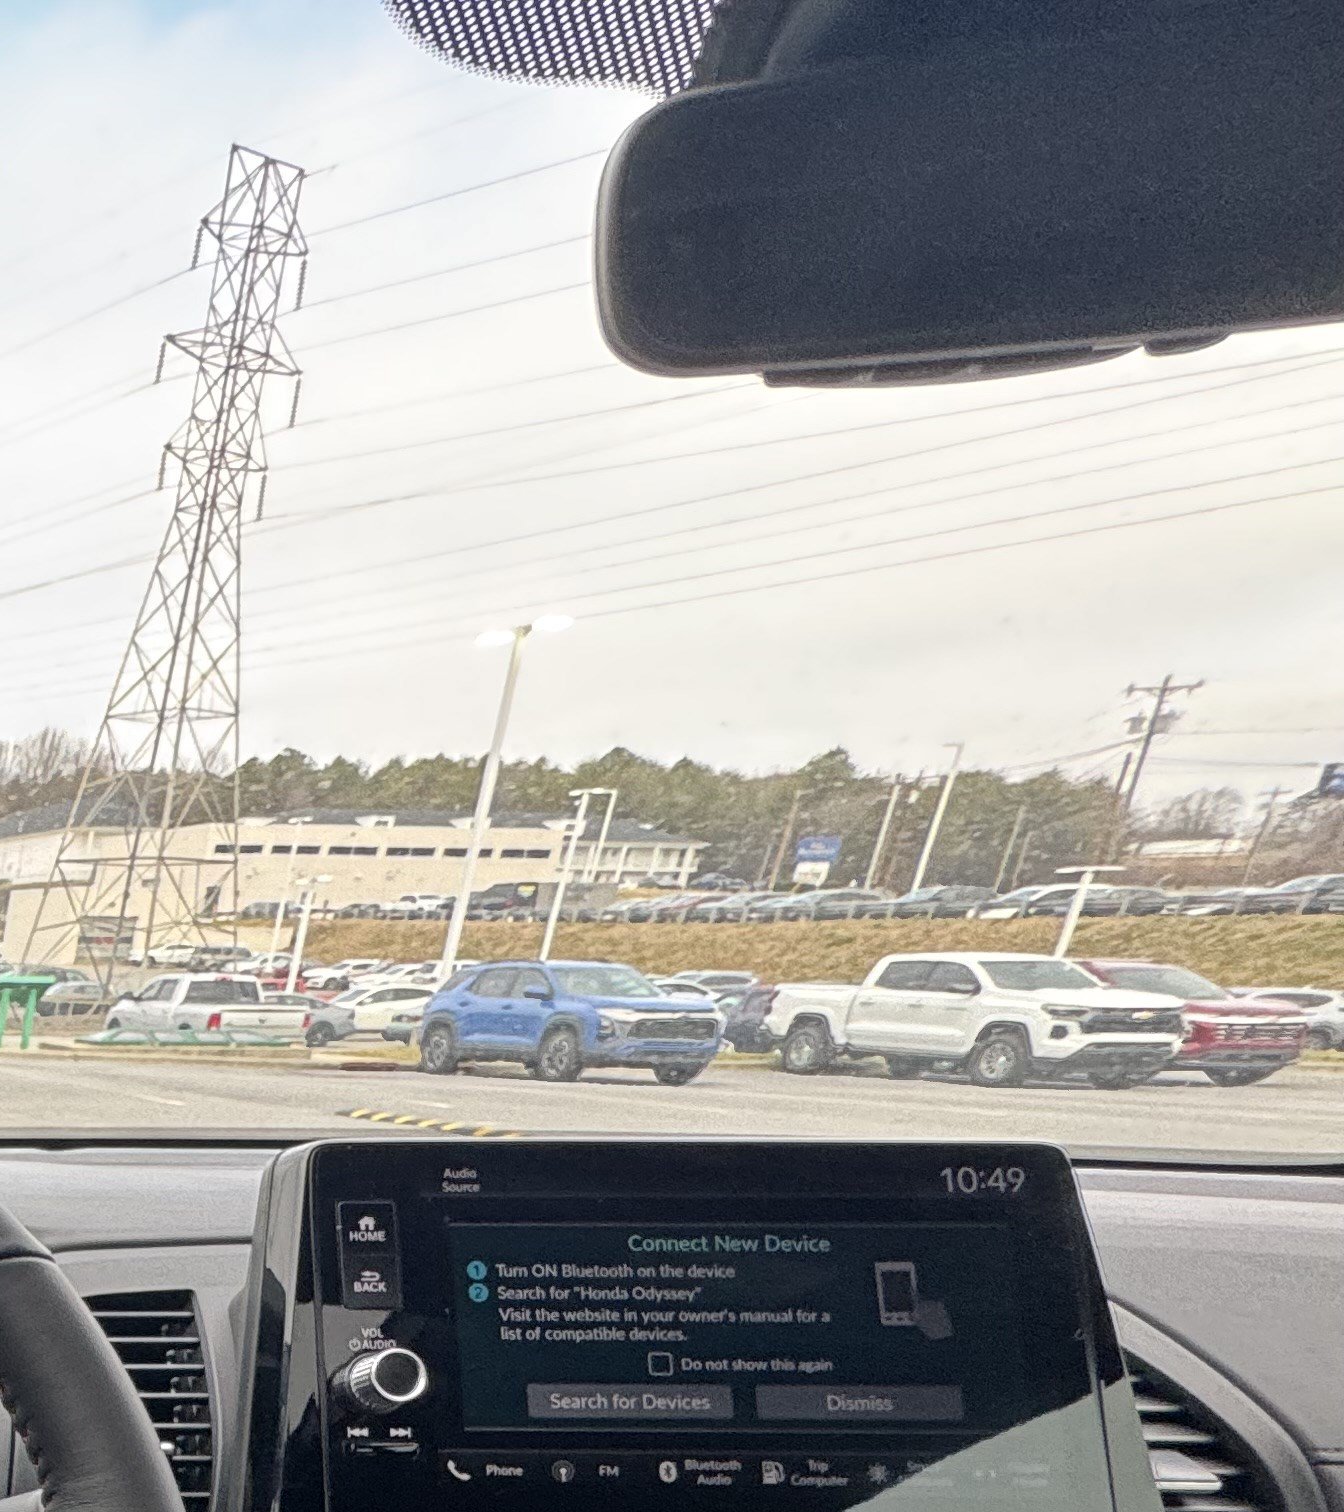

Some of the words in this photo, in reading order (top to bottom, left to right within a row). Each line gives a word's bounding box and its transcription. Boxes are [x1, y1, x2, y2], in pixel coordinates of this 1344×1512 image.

[443, 1168, 477, 1180] Audio
[939, 1166, 1025, 1194] 10:49
[441, 1181, 481, 1193] Source
[349, 1230, 386, 1242] HOME
[627, 1234, 708, 1252] Connect
[714, 1235, 758, 1252] New
[764, 1234, 831, 1252] Device
[495, 1263, 528, 1278] Turn
[531, 1263, 558, 1278] ON
[561, 1263, 633, 1278] Bluetooth
[637, 1266, 655, 1279] on
[659, 1264, 684, 1279] the
[687, 1264, 736, 1279] device
[353, 1281, 388, 1293] BACK
[497, 1286, 546, 1300] Search
[549, 1285, 570, 1300] for
[499, 1307, 539, 1322] Visit
[542, 1307, 560, 1322] the
[564, 1307, 620, 1322] website
[623, 1307, 638, 1322] in
[642, 1310, 673, 1325] your
[679, 1308, 736, 1323] owner's
[739, 1308, 793, 1323] manual
[796, 1308, 817, 1323] for
[820, 1312, 831, 1323] a
[361, 1325, 384, 1339] VOL
[500, 1326, 524, 1341] list
[527, 1326, 541, 1341] of
[544, 1326, 626, 1344] compatible
[629, 1326, 688, 1342] devices.
[362, 1339, 397, 1350] AUDIO
[681, 1357, 703, 1371] Do
[706, 1358, 729, 1371] not
[731, 1358, 768, 1371] show
[771, 1358, 795, 1372] this
[797, 1359, 833, 1374] again
[550, 1393, 609, 1411] Search
[612, 1393, 637, 1411] for
[642, 1394, 711, 1411] Devices
[825, 1394, 896, 1412] Dismiss
[486, 1463, 524, 1477] Phone
[598, 1464, 620, 1478] FM
[684, 1459, 743, 1472] Bluetooth
[696, 1473, 733, 1486] Audio
[790, 1474, 850, 1488] Computer
